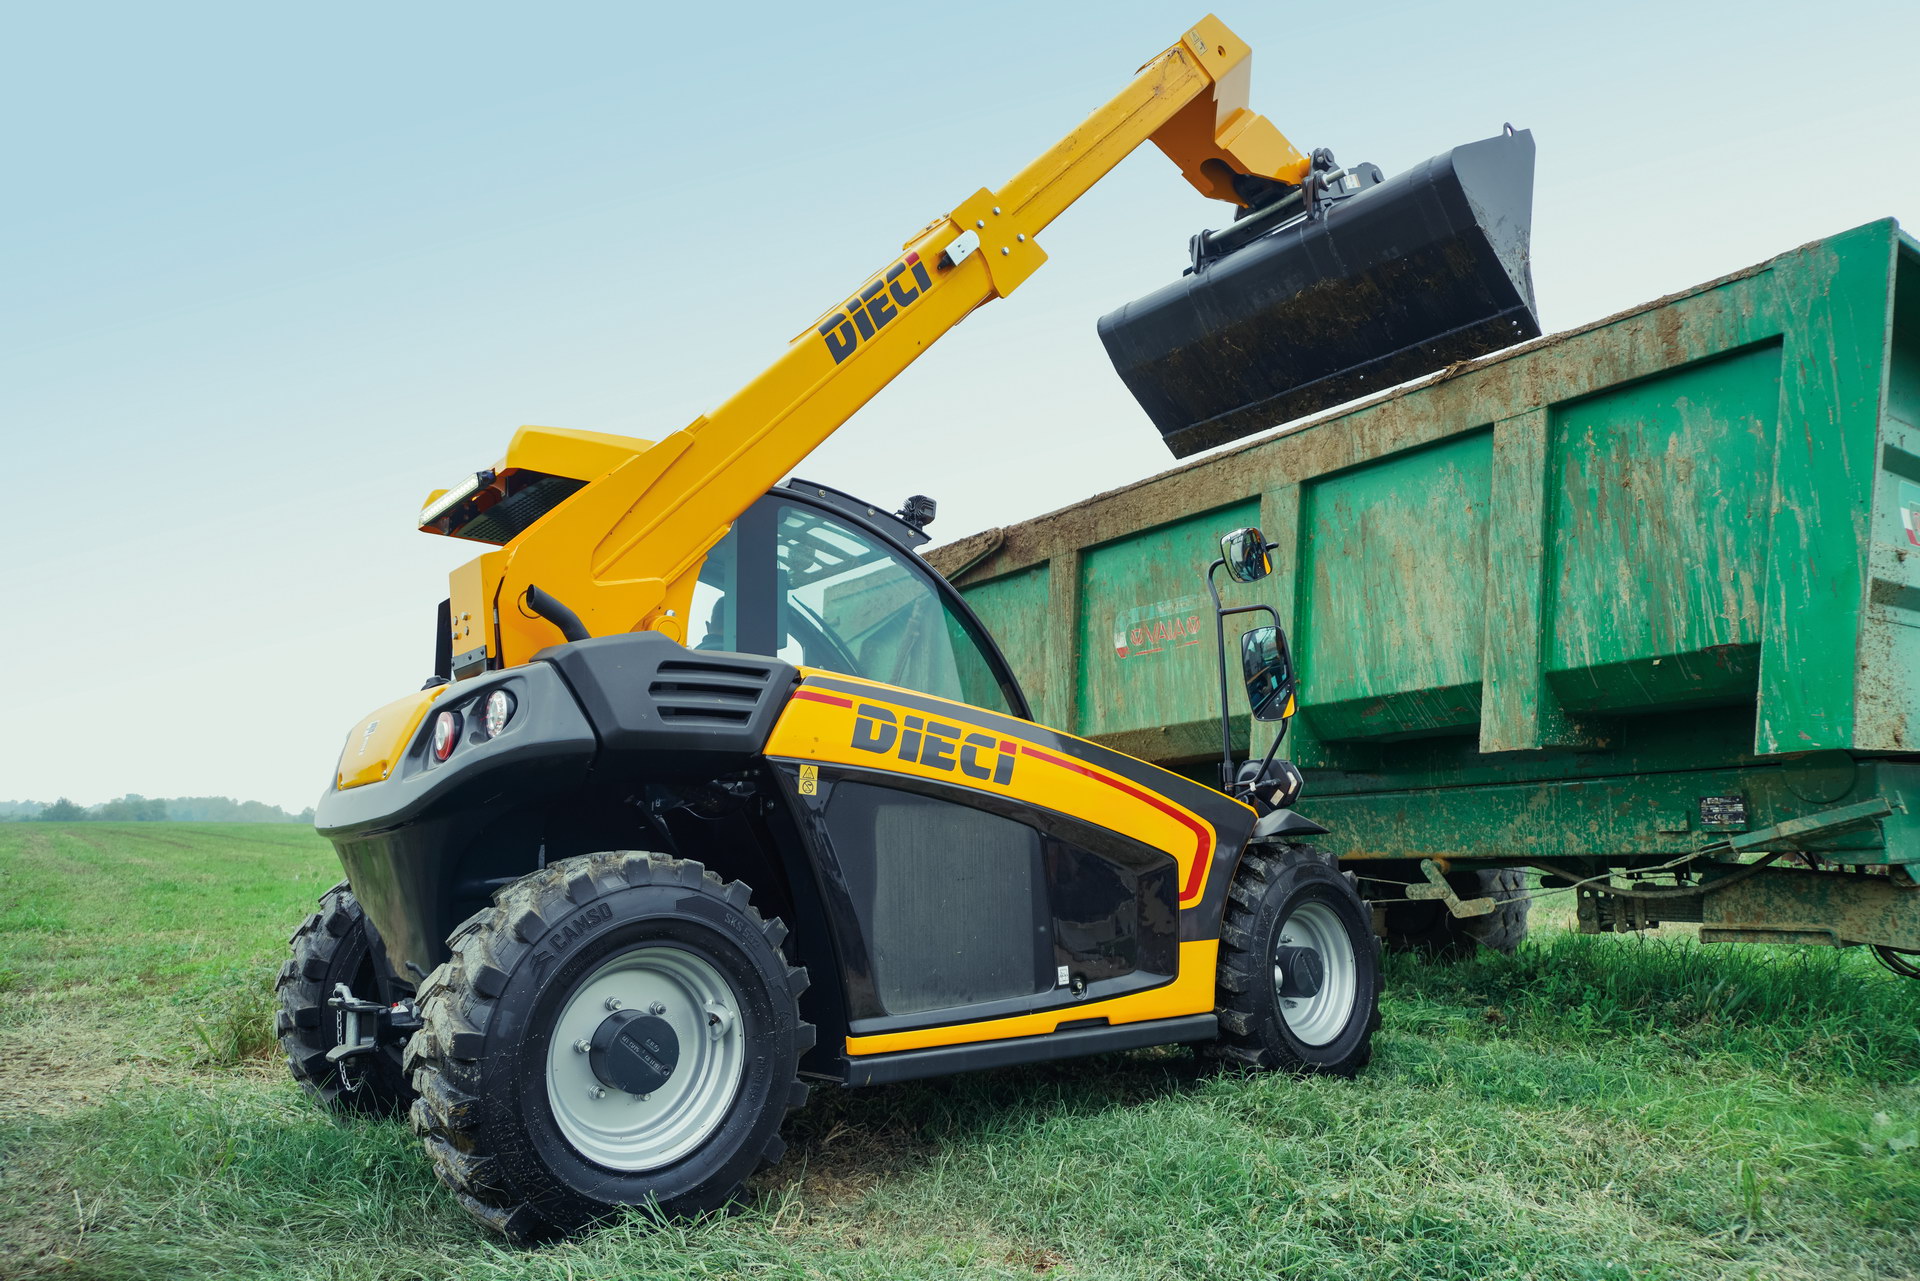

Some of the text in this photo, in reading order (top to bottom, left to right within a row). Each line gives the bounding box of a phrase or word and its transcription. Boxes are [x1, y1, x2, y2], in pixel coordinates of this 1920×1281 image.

[818, 251, 933, 366] DIECI
[850, 703, 1018, 786] DIECI
[549, 902, 614, 954] CAMSO
